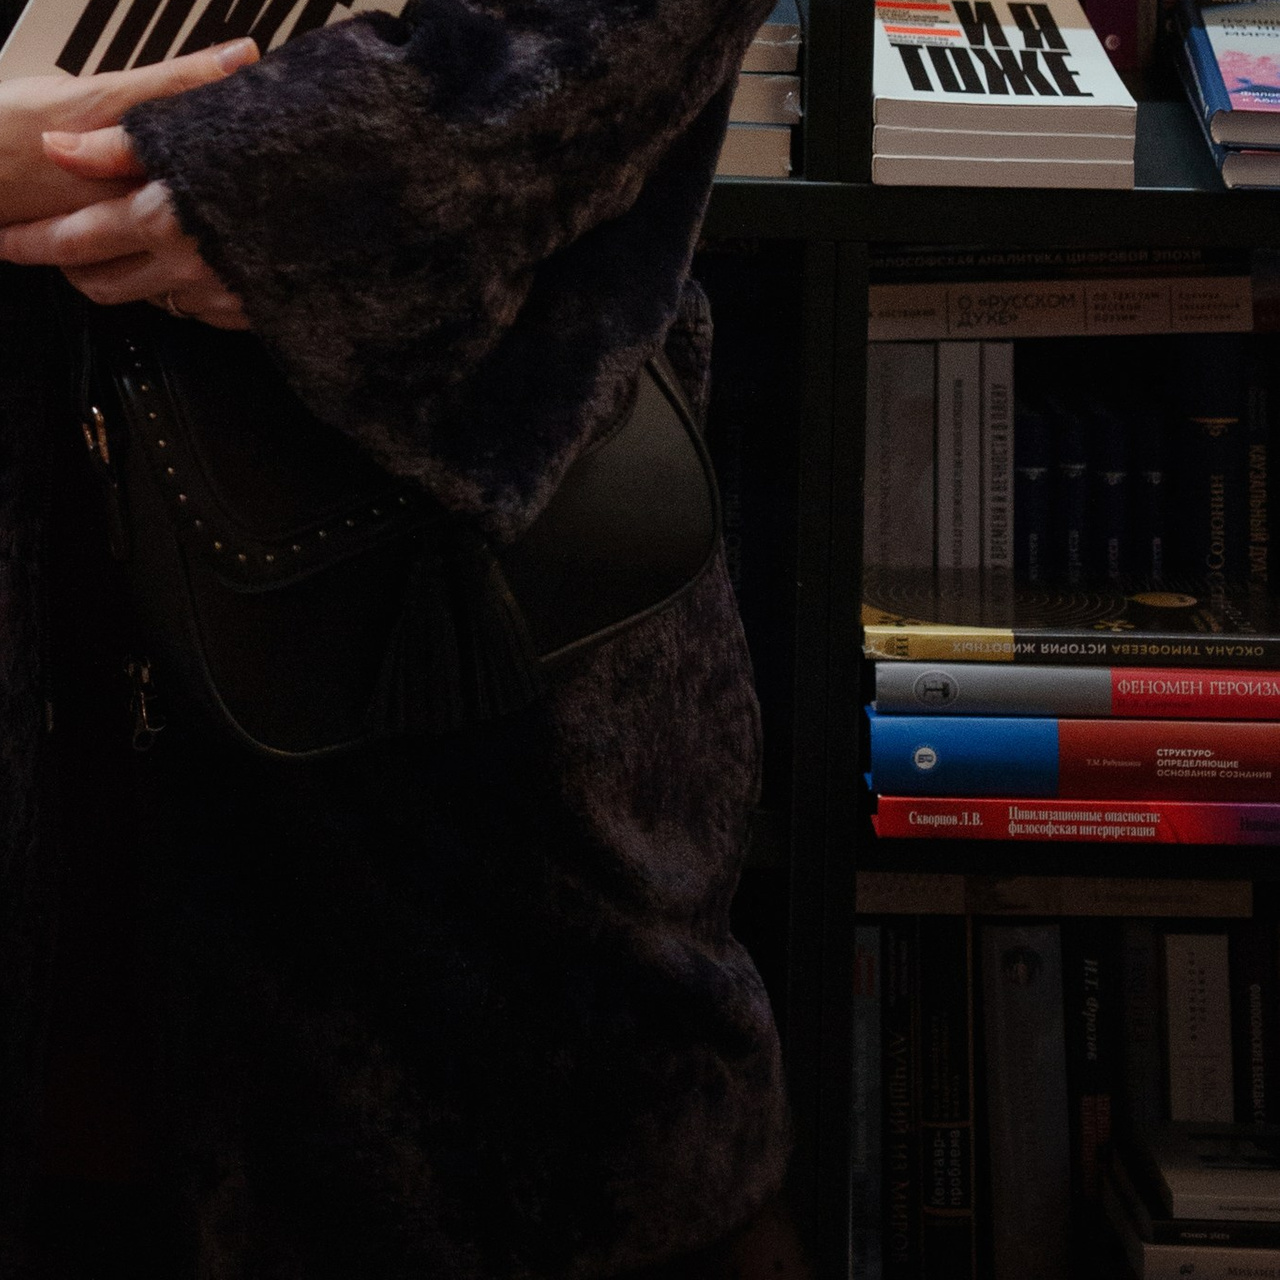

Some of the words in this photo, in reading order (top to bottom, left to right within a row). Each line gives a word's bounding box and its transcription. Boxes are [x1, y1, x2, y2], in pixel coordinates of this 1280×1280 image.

[950, 0, 1010, 47] И
[1007, 2, 1070, 50] Я
[890, 43, 1094, 98] ТОЖЕ
[1041, 642, 1107, 654] ИСТОРИЯ
[1118, 680, 1203, 696] ФЕНОМЕН
[1157, 748, 1215, 758] СТРУКТУРО-
[1157, 759, 1239, 769] ОПРЕДЕЛЯЮЩИЕ
[1157, 770, 1217, 778] ОСНОВАНИЯ
[1220, 771, 1271, 779] СОЗНАНИЯ
[909, 811, 957, 827] Скворцов
[959, 812, 983, 826] Л.В.
[1009, 806, 1102, 822] Цивилизационные
[1105, 810, 1161, 823] опасности:
[1008, 822, 1077, 837] философская
[1080, 824, 1155, 838] интерпретация
